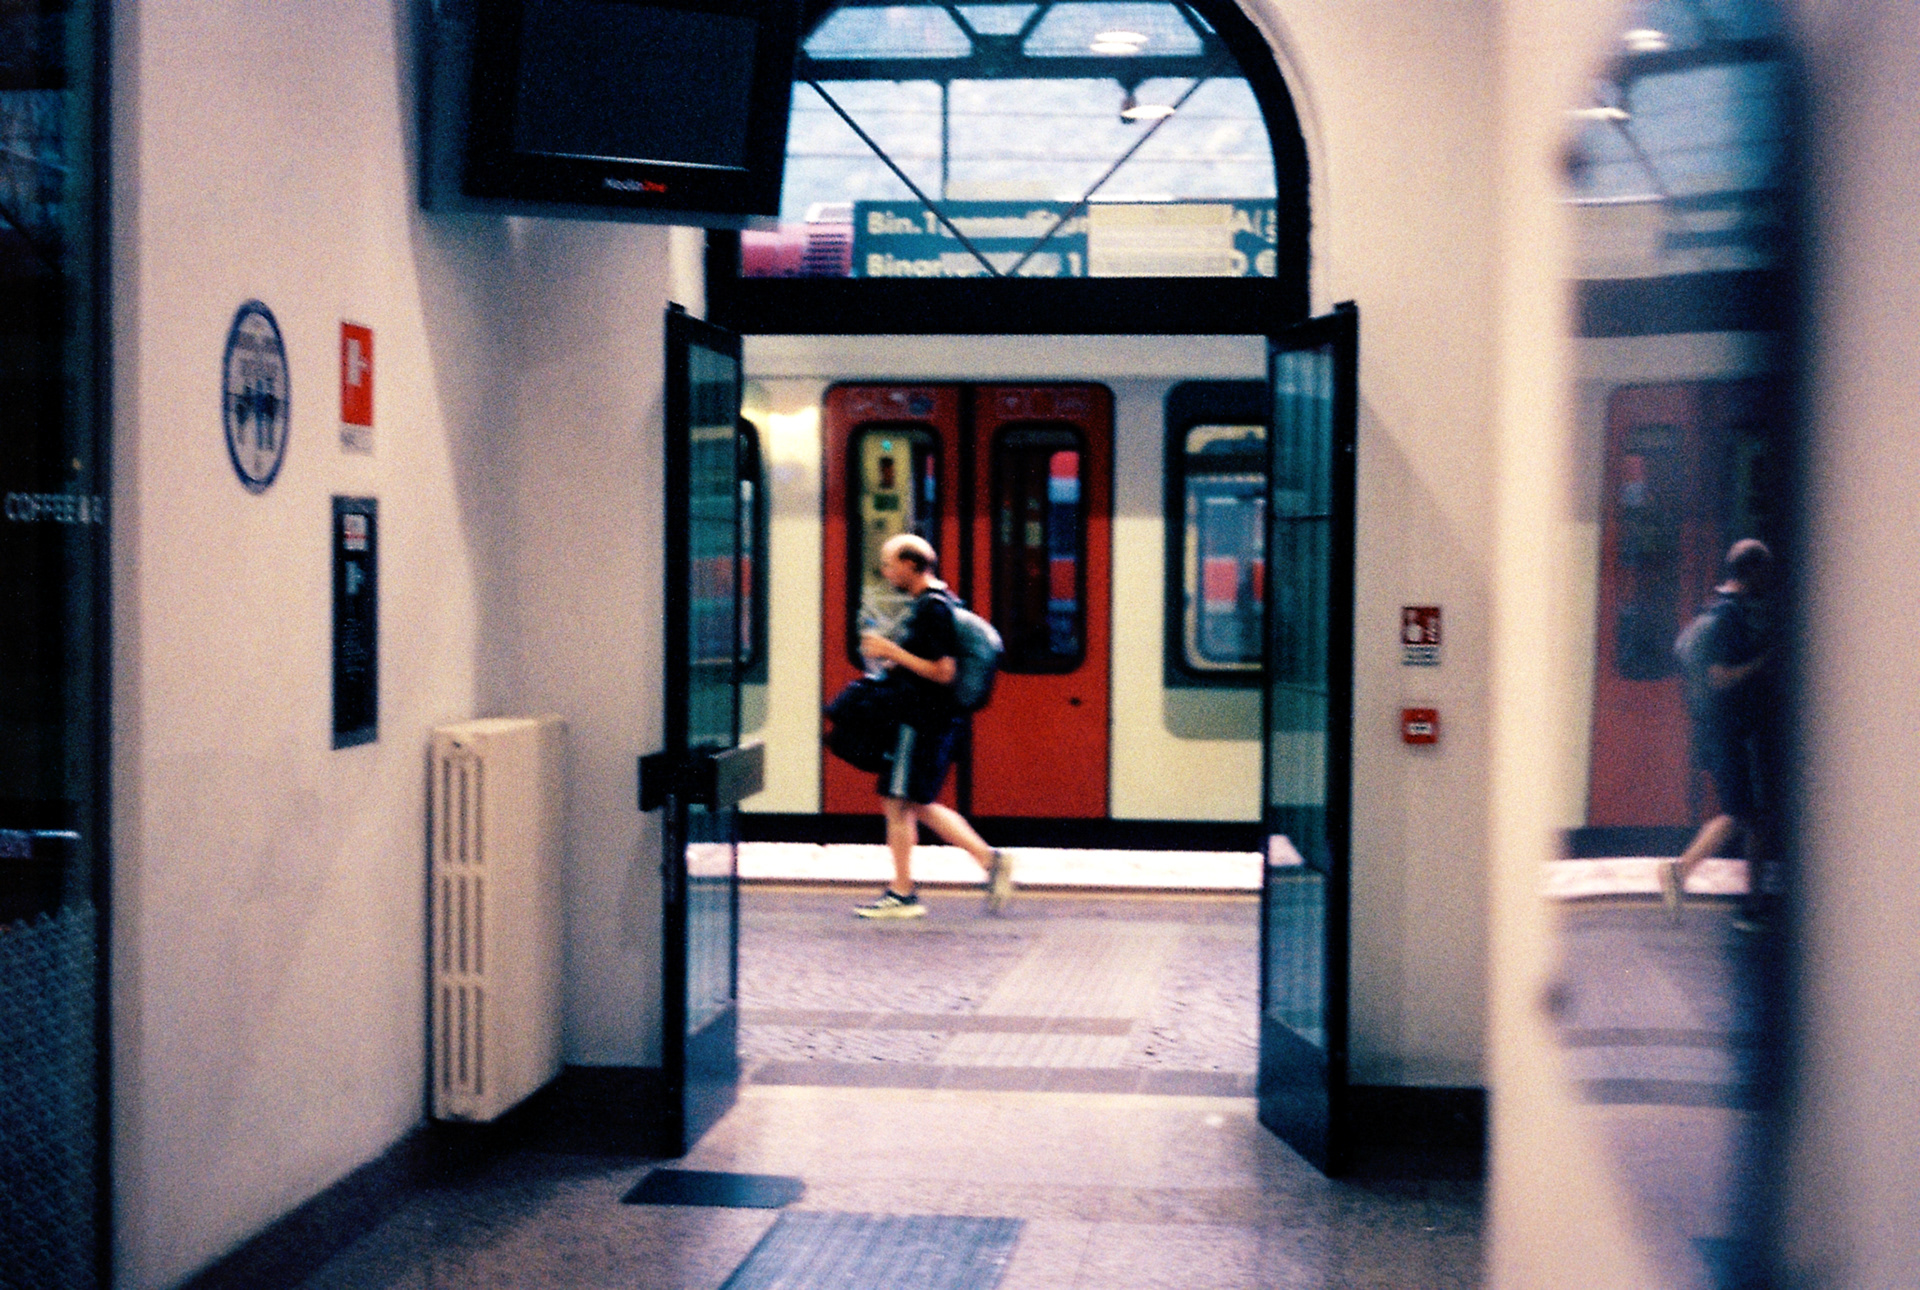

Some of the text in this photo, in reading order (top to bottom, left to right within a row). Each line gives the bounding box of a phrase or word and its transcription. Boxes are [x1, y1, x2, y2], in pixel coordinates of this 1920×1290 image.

[867, 210, 922, 234] Bin.
[922, 210, 937, 234] 1
[4, 491, 76, 524] COFFEE
